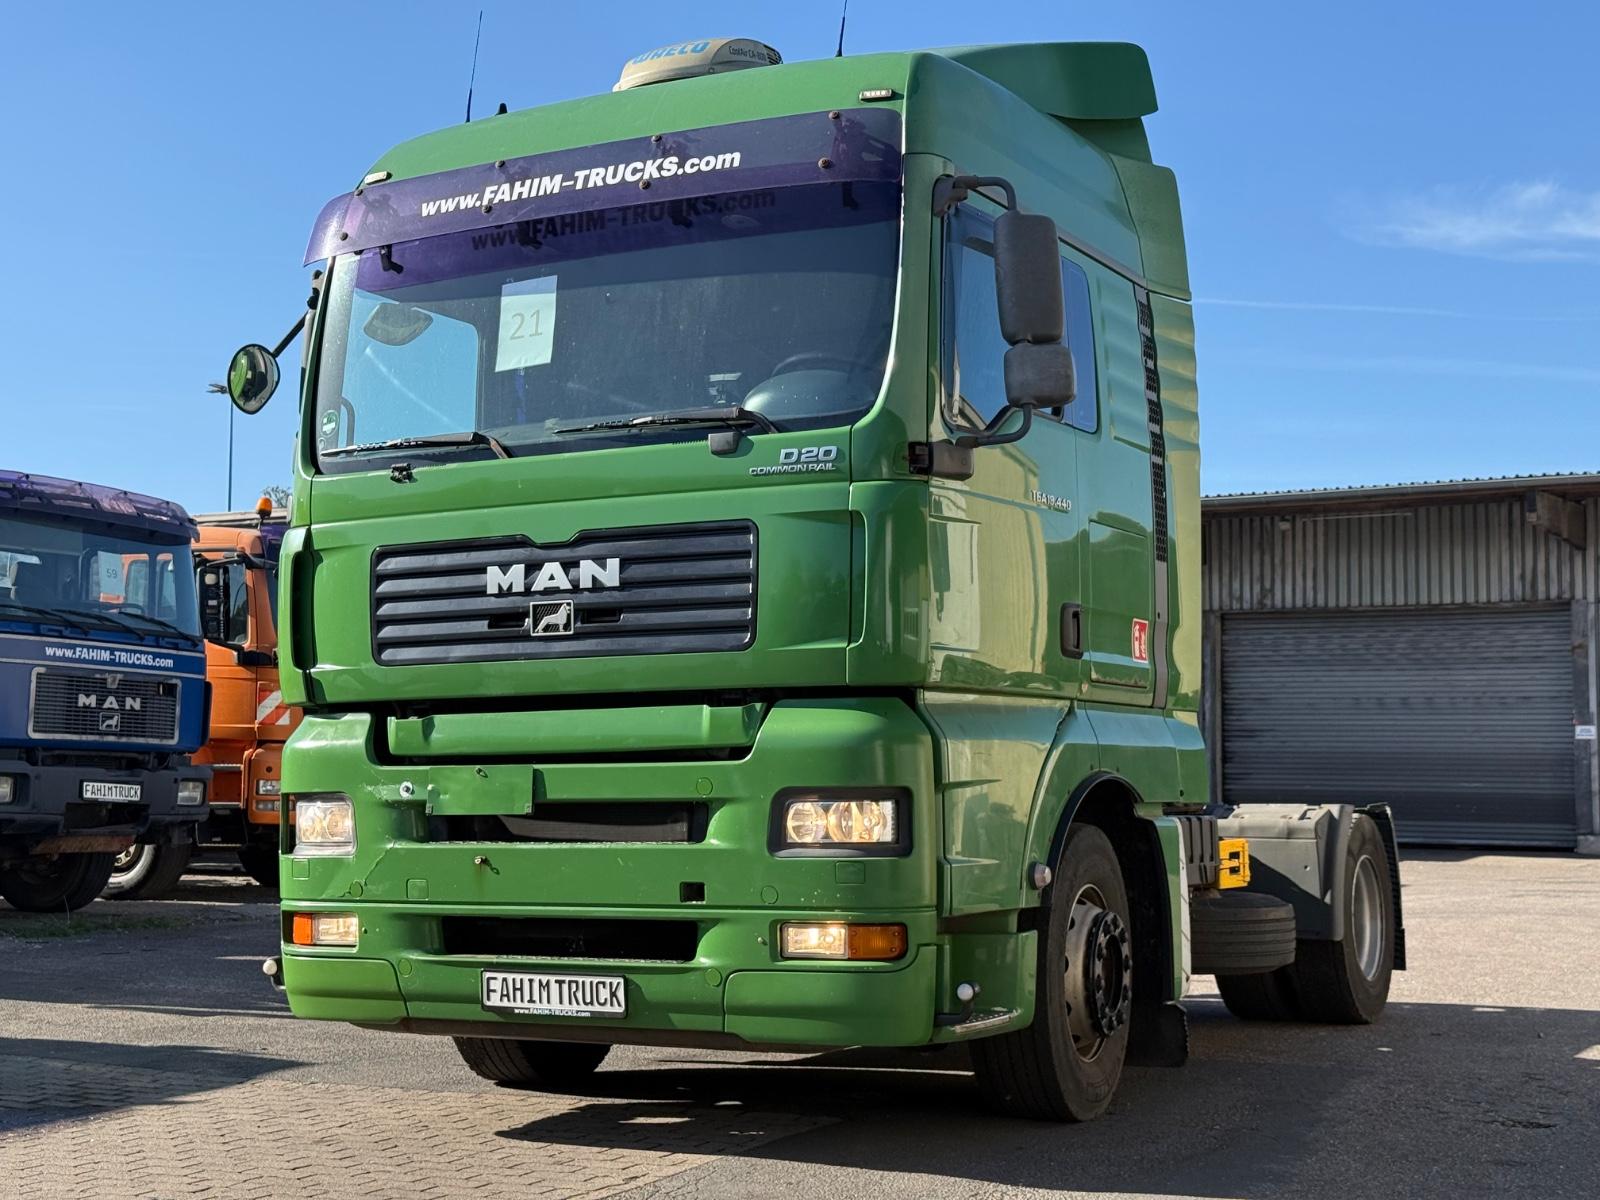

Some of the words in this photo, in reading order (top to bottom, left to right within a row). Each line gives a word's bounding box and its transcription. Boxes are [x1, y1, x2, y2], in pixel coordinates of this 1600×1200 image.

[420, 151, 741, 217] www.FAHIM-TRUCKS.com
[510, 309, 543, 341] 21
[779, 445, 838, 464] D20
[749, 464, 807, 475] COMMON
[808, 462, 836, 471] RAIL
[486, 558, 620, 595] MAN
[45, 646, 174, 668] www.FAHIM-TRUCKS.com
[77, 693, 141, 711] MAN
